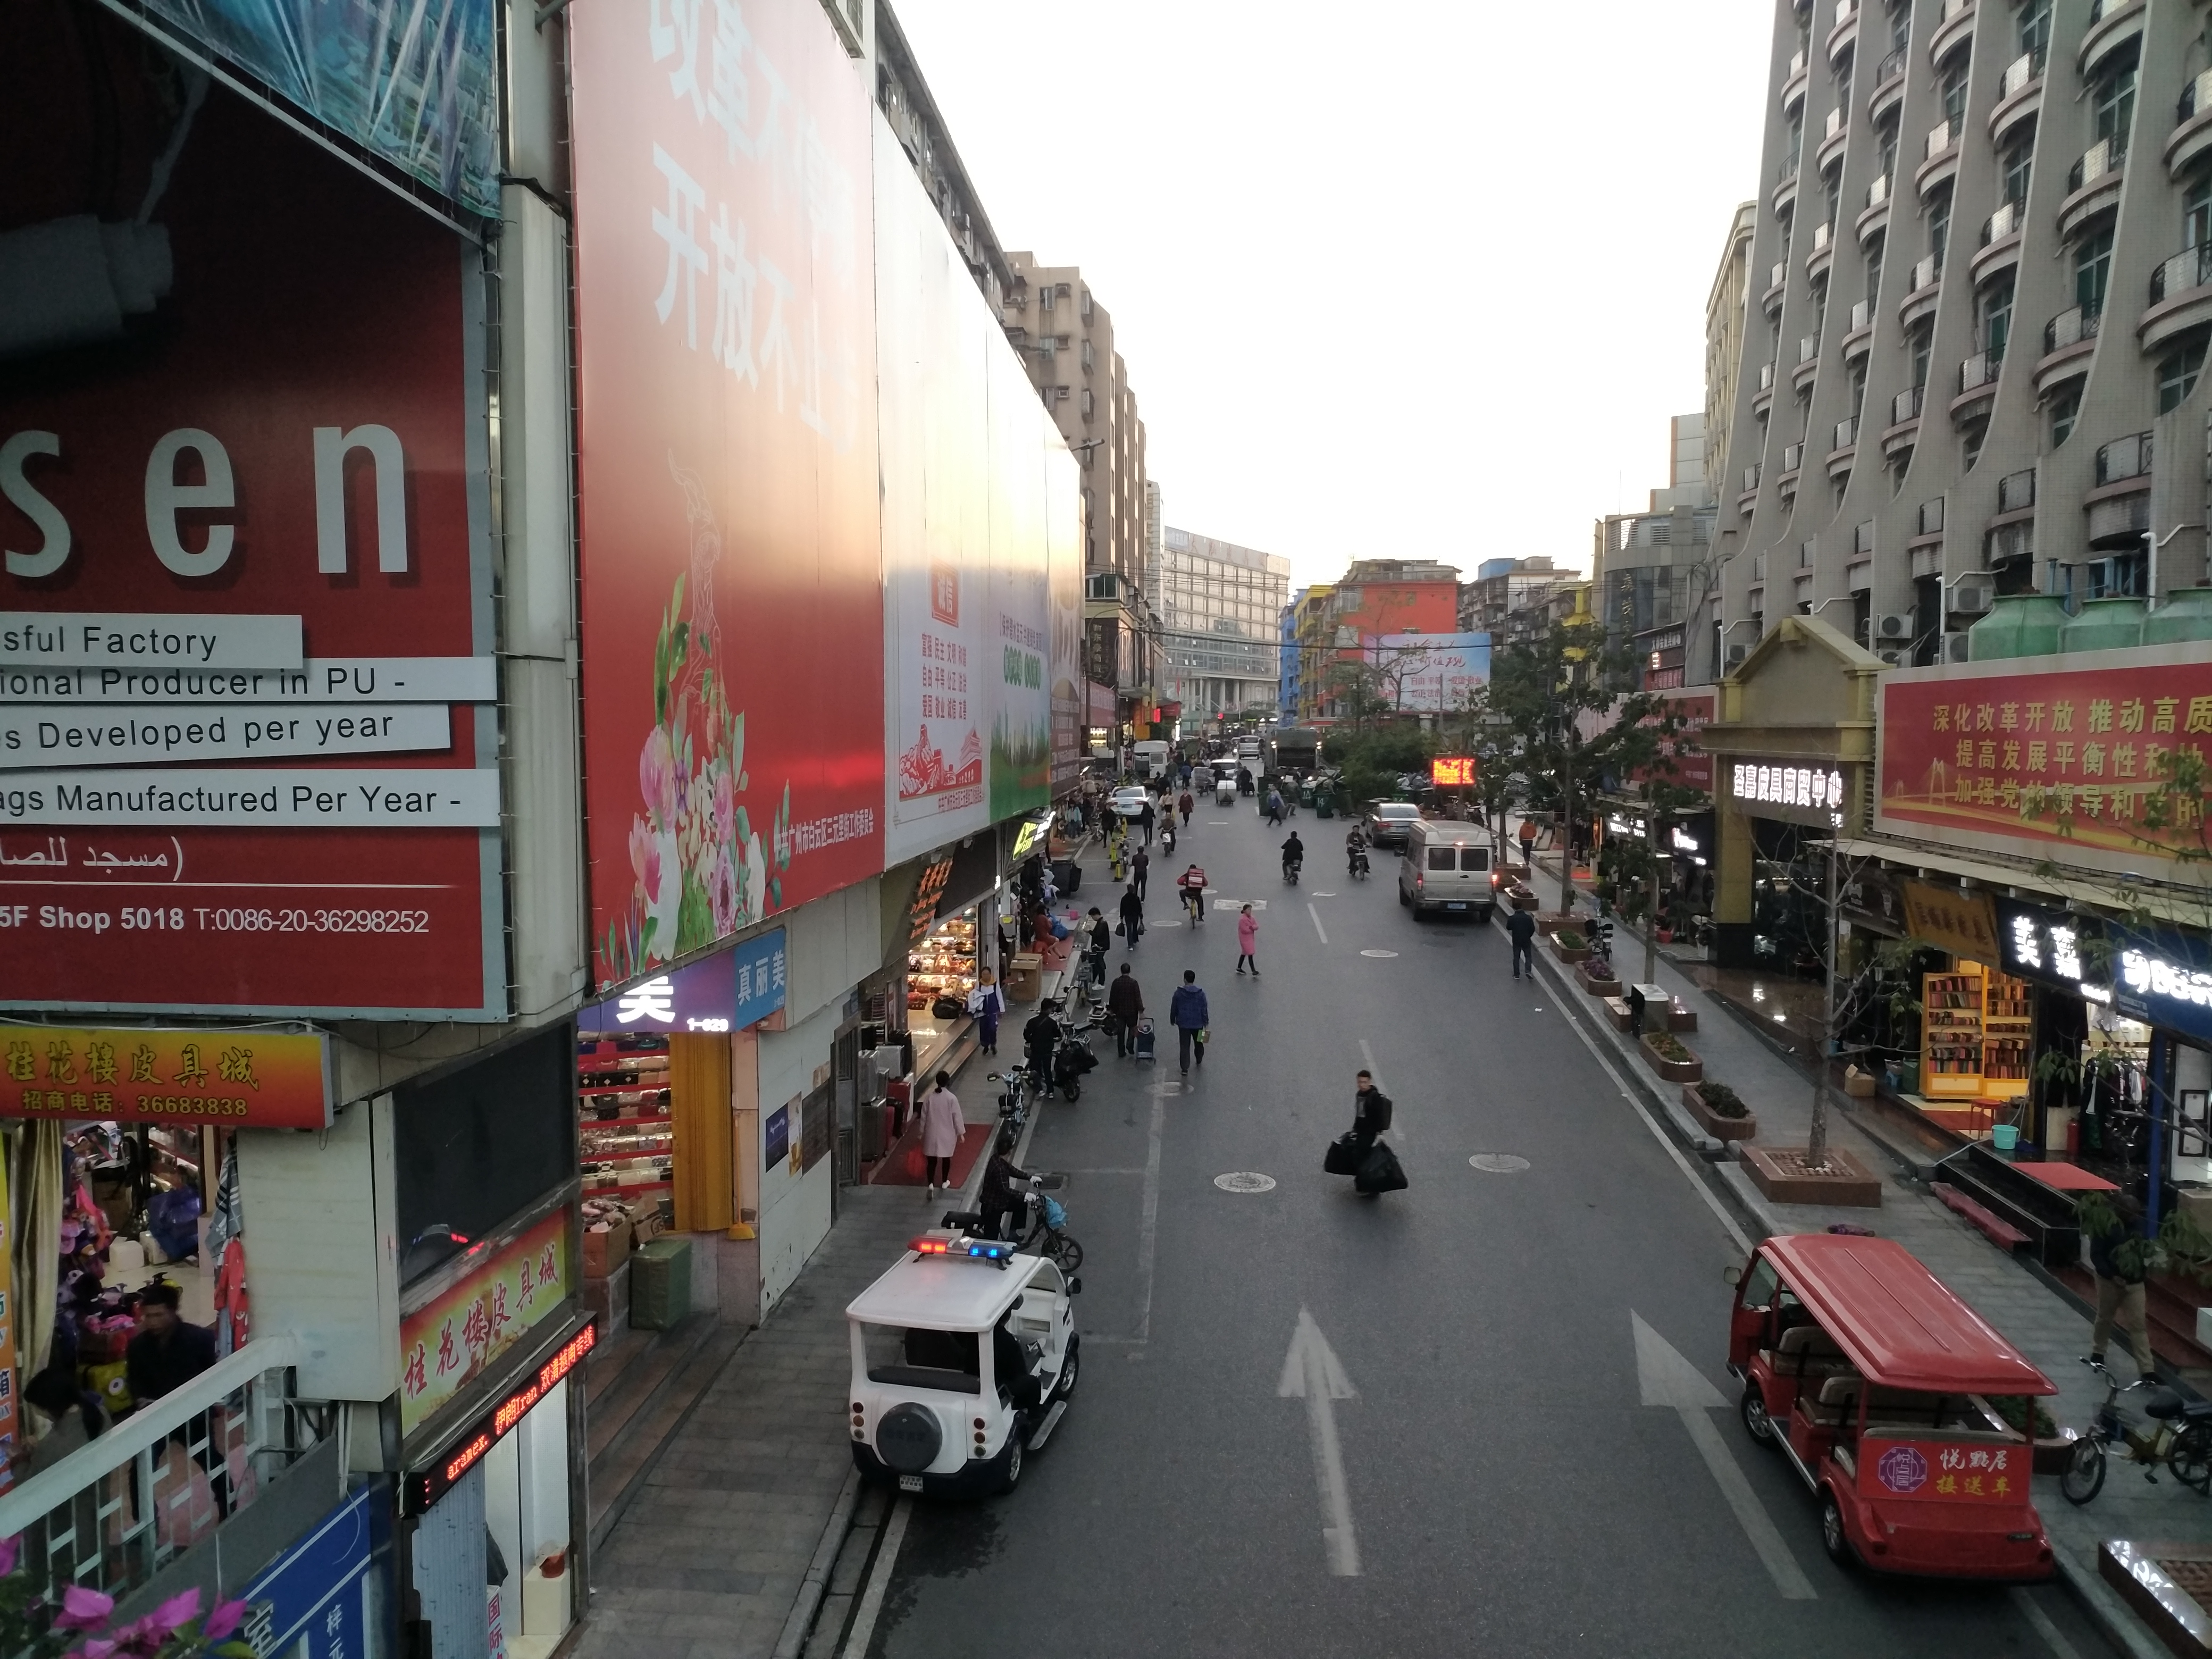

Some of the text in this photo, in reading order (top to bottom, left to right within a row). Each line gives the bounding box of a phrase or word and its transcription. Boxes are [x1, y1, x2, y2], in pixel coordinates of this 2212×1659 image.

[4, 625, 216, 662] sful Factory
[935, 637, 945, 661] 民主
[947, 641, 956, 665] 文明
[0, 668, 81, 695] ional
[101, 668, 263, 695] Producer
[280, 668, 308, 694] in
[327, 667, 375, 694] PU
[923, 663, 932, 689] 自由
[935, 666, 945, 691] 平等
[948, 671, 956, 691] 公正
[1411, 676, 1425, 685] 自由
[922, 694, 933, 718] 爱国
[958, 699, 967, 720] 友善
[1933, 695, 2212, 735] 深化改革开放 推动高质
[38, 716, 225, 751] Developed
[245, 718, 299, 748] per
[316, 714, 393, 745] year
[56, 784, 278, 812] Manufactured
[292, 786, 348, 812] Per
[359, 786, 437, 812] Year
[1733, 764, 1842, 809] 圣嘉皮具商贸中心
[0, 905, 430, 935] 5F Shop 5018 T:0086-20-36298252
[738, 949, 785, 1007] 真丽美
[137, 1095, 248, 1116] 36683838
